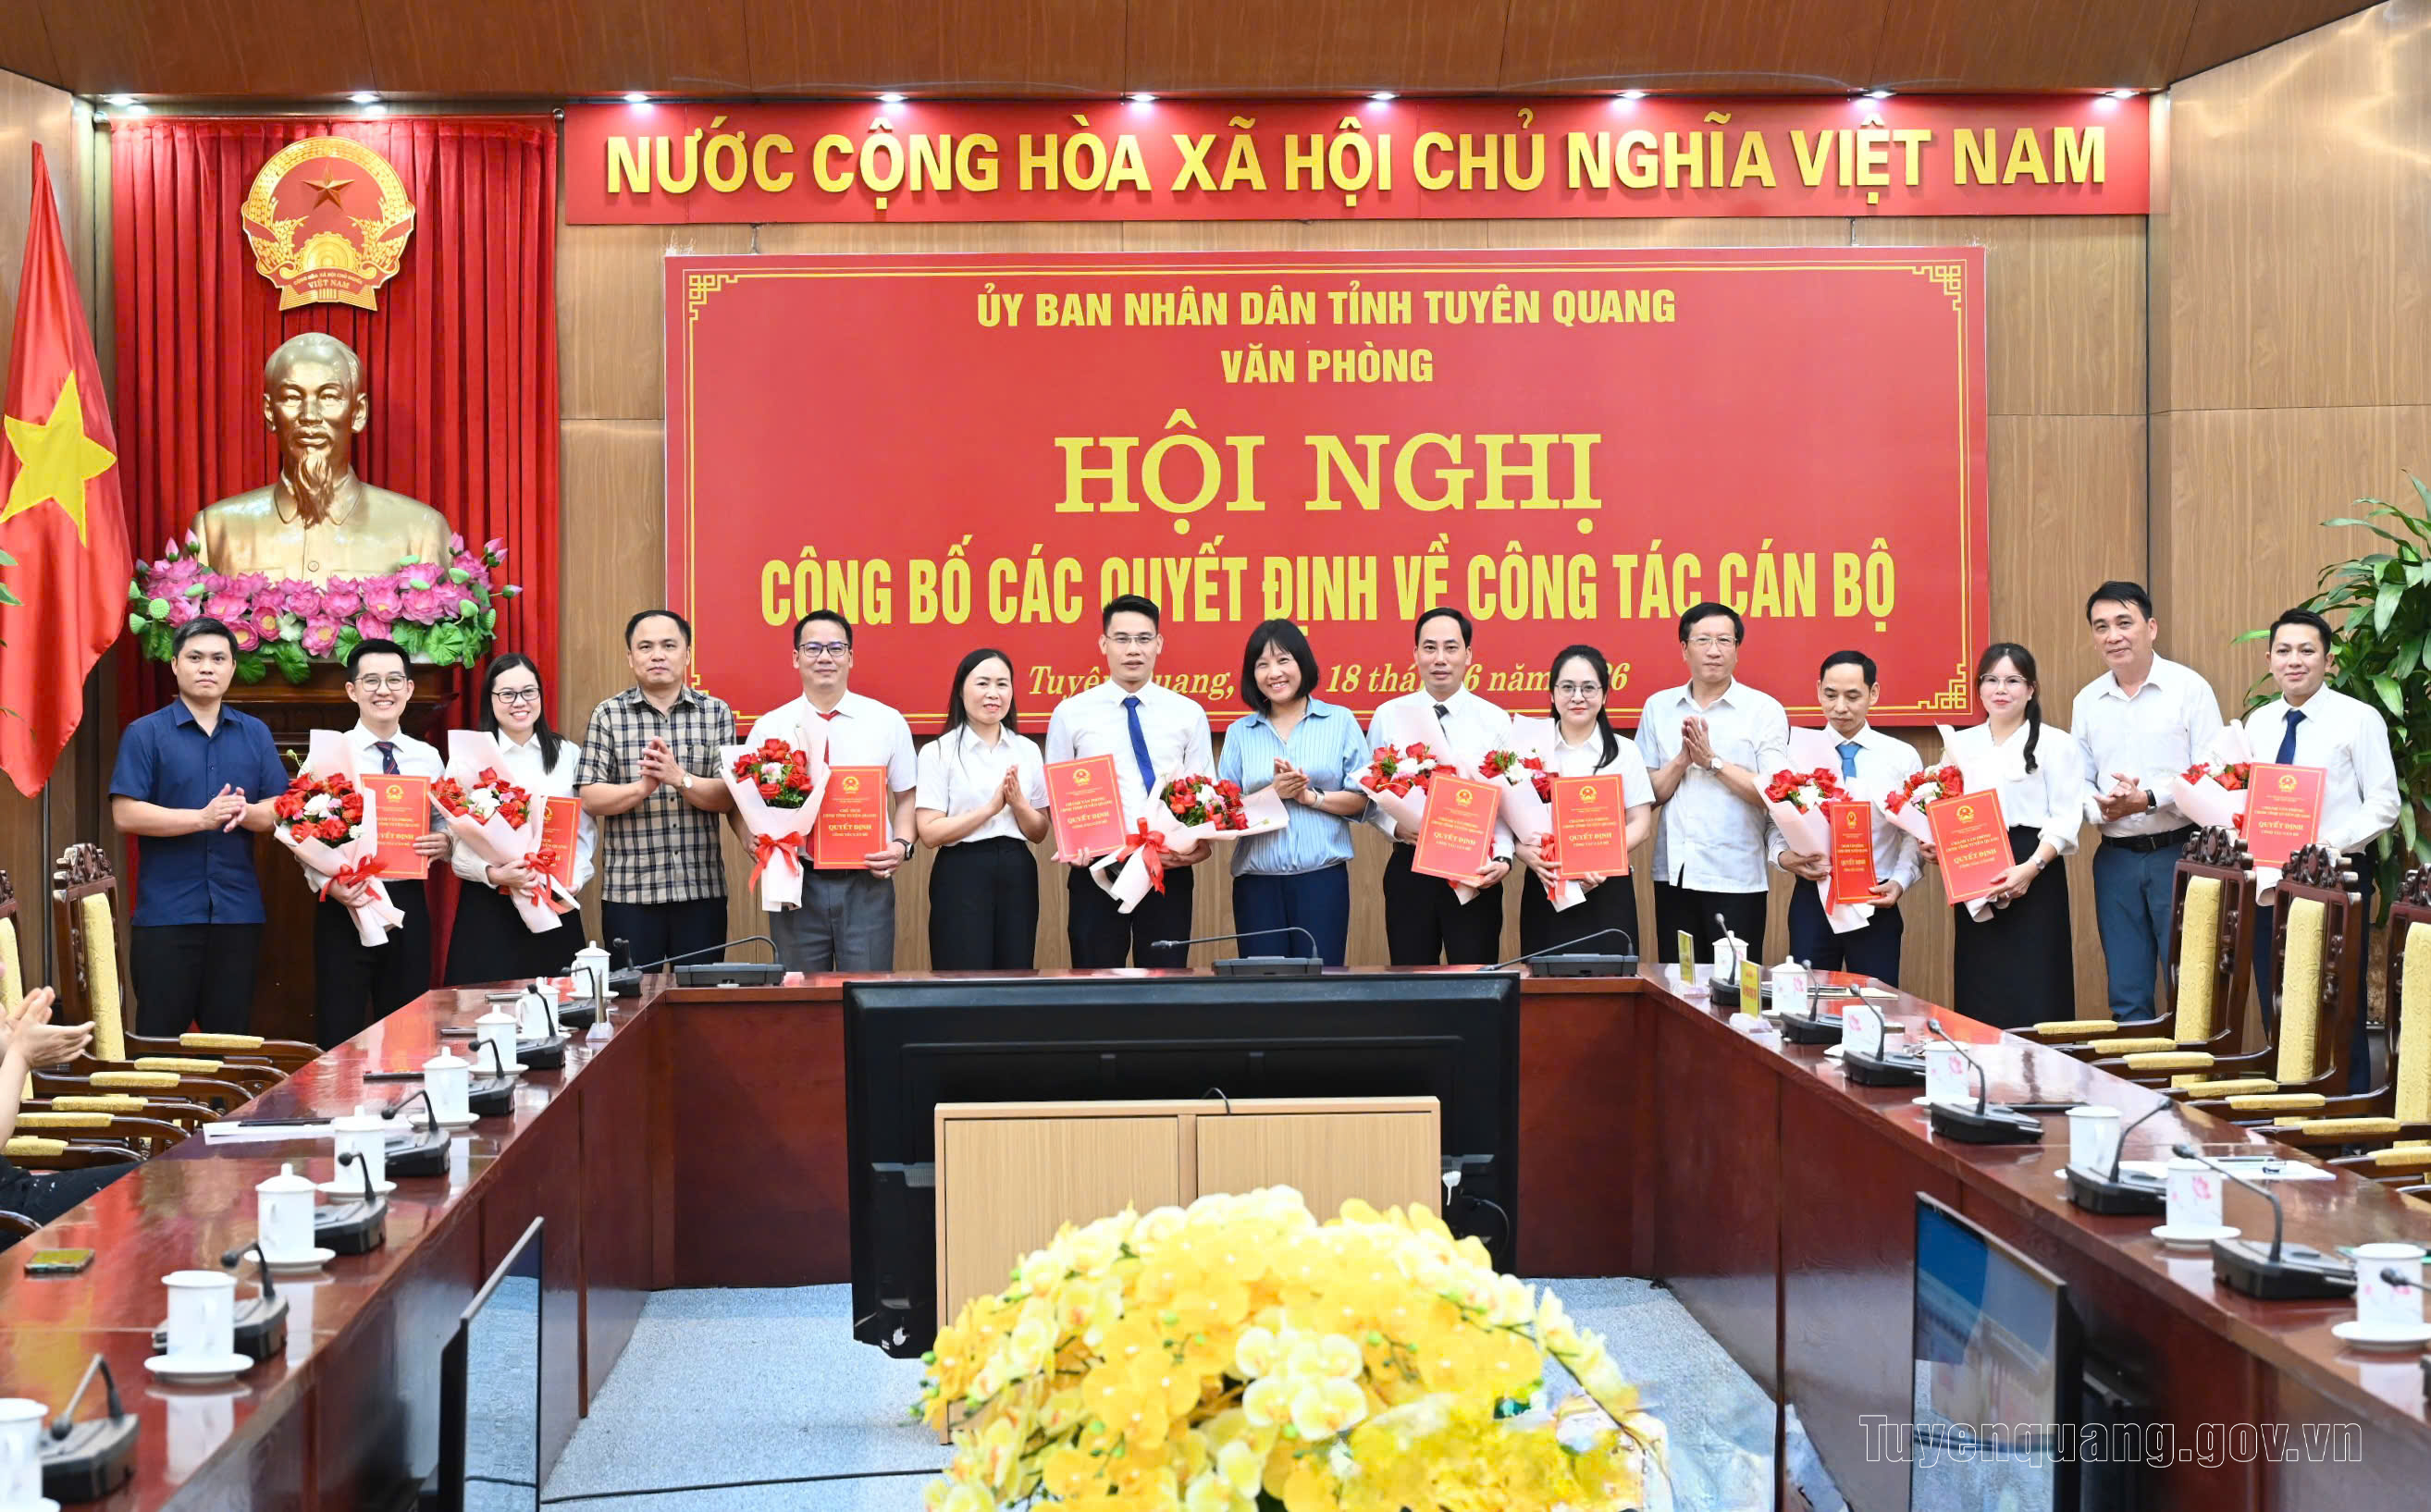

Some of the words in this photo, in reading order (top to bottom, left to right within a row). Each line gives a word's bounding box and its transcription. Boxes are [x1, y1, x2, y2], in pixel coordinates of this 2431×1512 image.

[607, 116, 794, 193] NƯỚC
[812, 118, 999, 210] CỘNG
[1018, 114, 1152, 191] HÒA
[1170, 117, 1265, 191] XÃ
[1286, 117, 1392, 207] HỘI
[1413, 108, 1546, 191] CHỦ
[1567, 111, 1777, 189] NGHĨA
[1790, 117, 1932, 205] VIỆT
[1953, 126, 2107, 185] NAM
[330, 279, 350, 289] NAM
[977, 282, 1024, 327] ỦY
[1035, 292, 1112, 326] BAN
[1124, 285, 1228, 326] NHÂN
[1240, 284, 1316, 326] DÂN
[1327, 280, 1413, 325] TỈNH
[1423, 283, 1540, 325] TUYÊN
[1552, 289, 1676, 326] QUANG
[1220, 342, 1295, 384] VĂN
[1307, 340, 1434, 384] PHÒNG
[1054, 408, 1266, 535] HỘI
[1304, 432, 1602, 535] NGHỊ
[761, 545, 892, 627] CÔNG
[908, 534, 973, 625] BỐ
[988, 543, 1083, 625] CÁC
[1100, 534, 1248, 622] QUYẾT
[1261, 555, 1377, 637] ĐỊNH
[1392, 532, 1450, 621] VỀ
[1467, 539, 1598, 621] CÔNG
[1612, 538, 1702, 620] TÁC
[1718, 537, 1817, 619] CÁN
[1833, 536, 1895, 633] BỘ
[1029, 665, 1111, 700] Tuyê
[1151, 671, 1235, 701] uang,
[1325, 664, 1363, 694] 18
[1368, 662, 1425, 694] thá
[1487, 662, 1551, 692] năm
